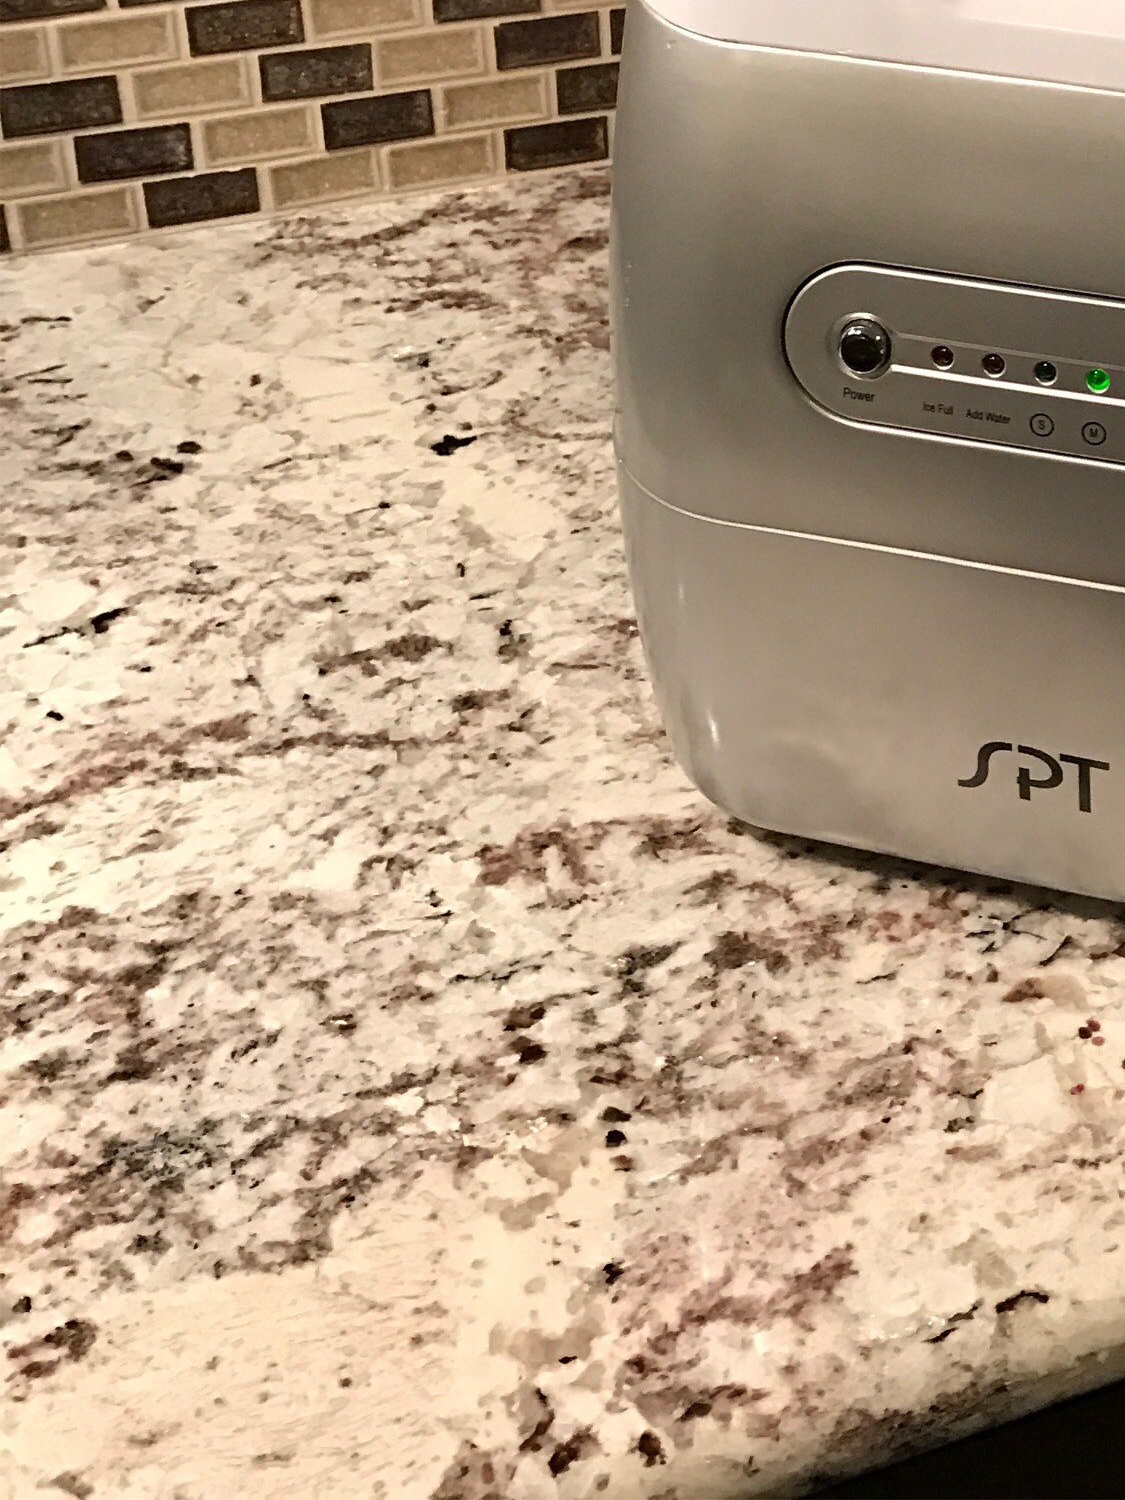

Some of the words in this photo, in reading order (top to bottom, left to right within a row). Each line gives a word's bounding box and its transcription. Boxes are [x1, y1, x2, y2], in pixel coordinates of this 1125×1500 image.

[843, 386, 876, 402] Power
[965, 408, 984, 420] Add
[985, 411, 1011, 424] Water
[957, 741, 1110, 813] SPT
